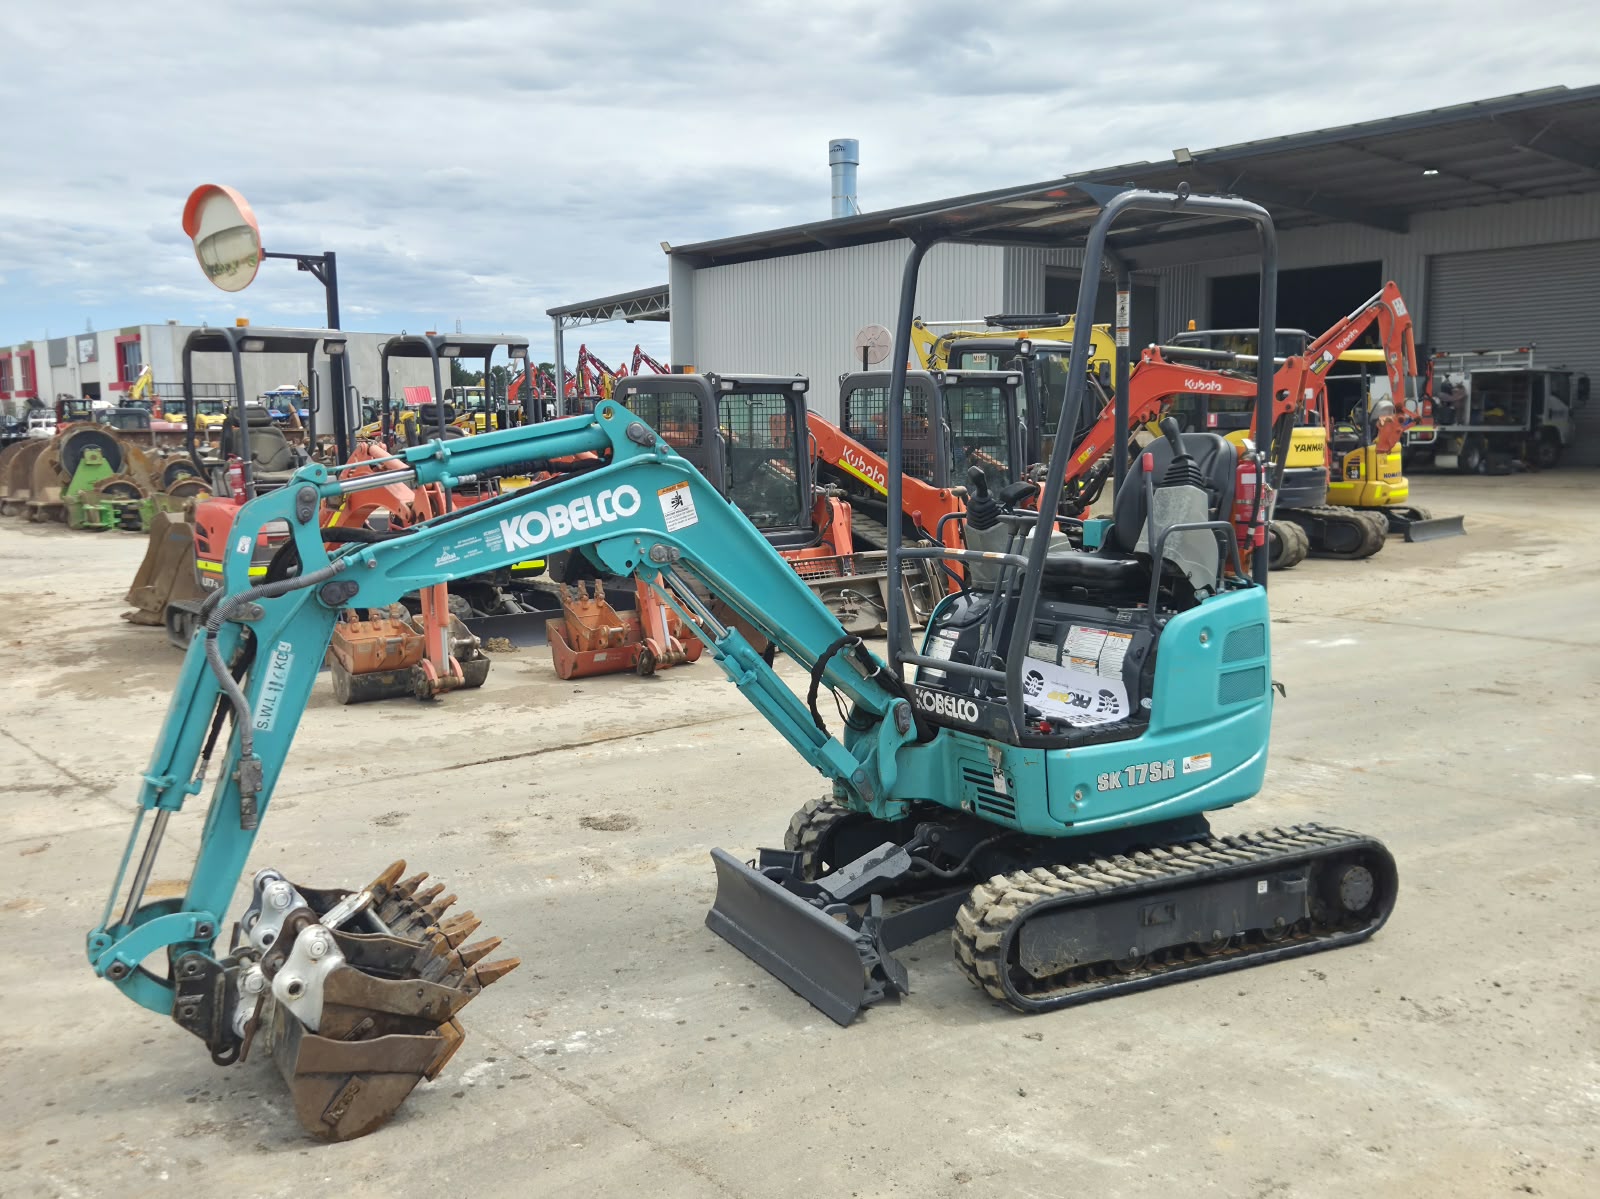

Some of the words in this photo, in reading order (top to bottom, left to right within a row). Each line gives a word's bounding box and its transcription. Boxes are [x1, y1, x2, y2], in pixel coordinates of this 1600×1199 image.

[1336, 328, 1359, 350] Kubota
[1184, 379, 1223, 392] Kubota
[843, 445, 886, 487] Kubota
[500, 484, 642, 552] KOBELCO
[915, 689, 979, 723] KOBELCO
